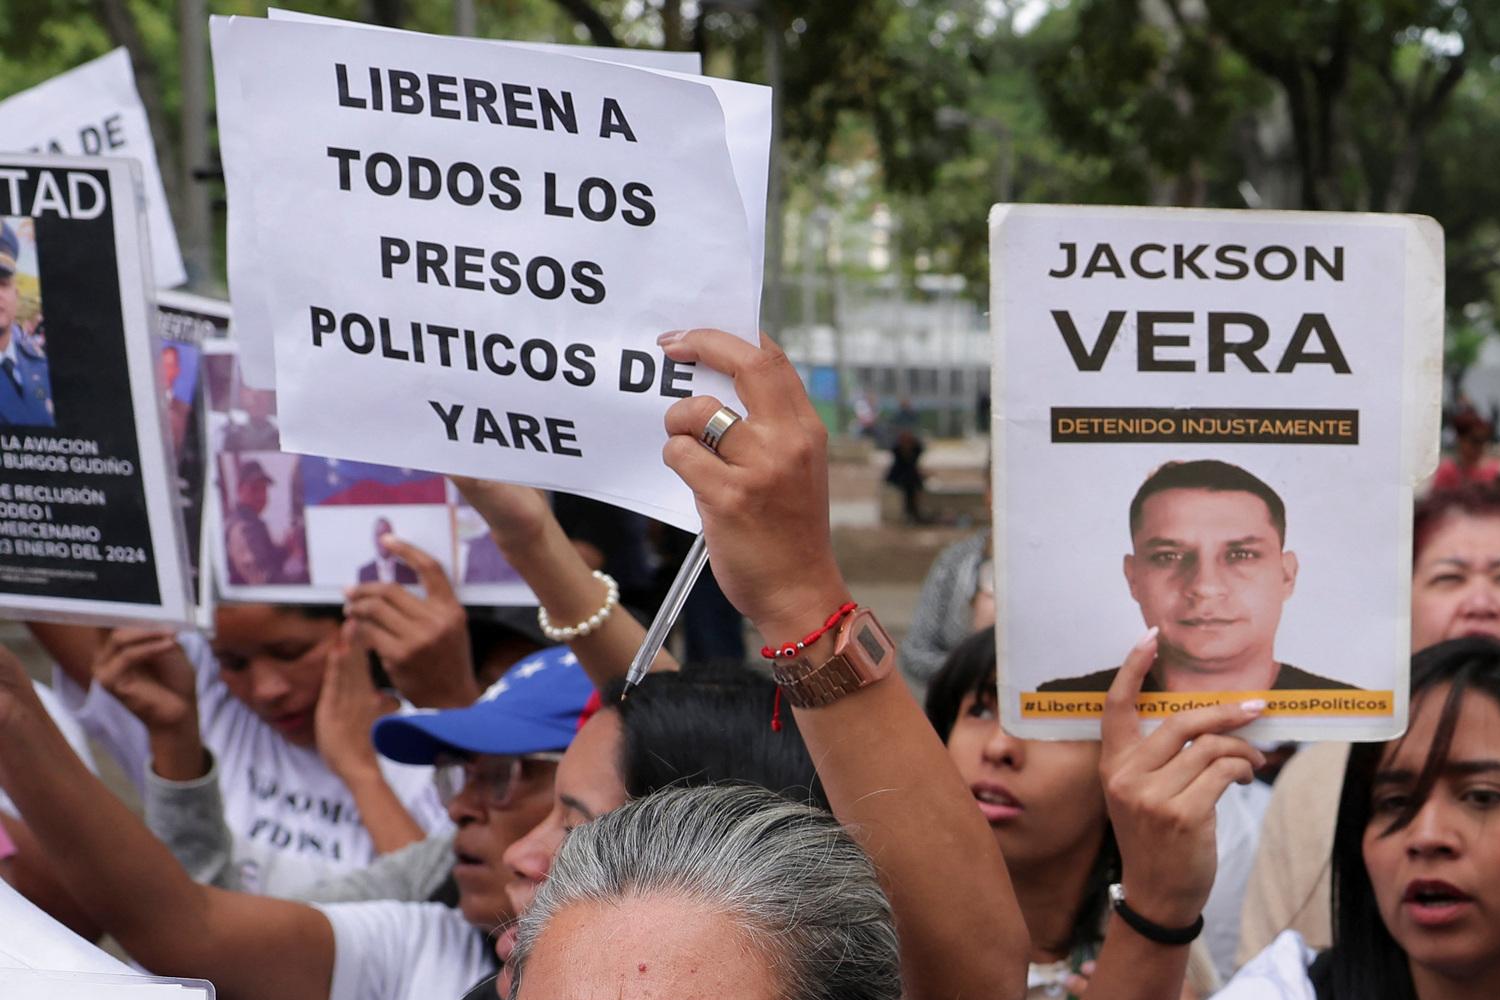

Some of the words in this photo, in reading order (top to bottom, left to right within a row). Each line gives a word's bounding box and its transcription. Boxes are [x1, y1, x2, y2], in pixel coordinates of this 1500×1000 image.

[81, 114, 125, 156] DE
[335, 63, 577, 135] LIBEREN
[599, 97, 637, 143] A
[327, 147, 521, 212] TODOS
[543, 173, 656, 228] LOS
[380, 236, 607, 305] PRESOS
[1048, 242, 1345, 281] JACKSON
[310, 306, 597, 388] POLITICOS
[619, 349, 695, 399] DE
[1050, 310, 1352, 374] VERA
[429, 400, 583, 458] YARE
[1058, 418, 1175, 435] DETENIDO
[1182, 419, 1352, 437] INJUSTAMENTE
